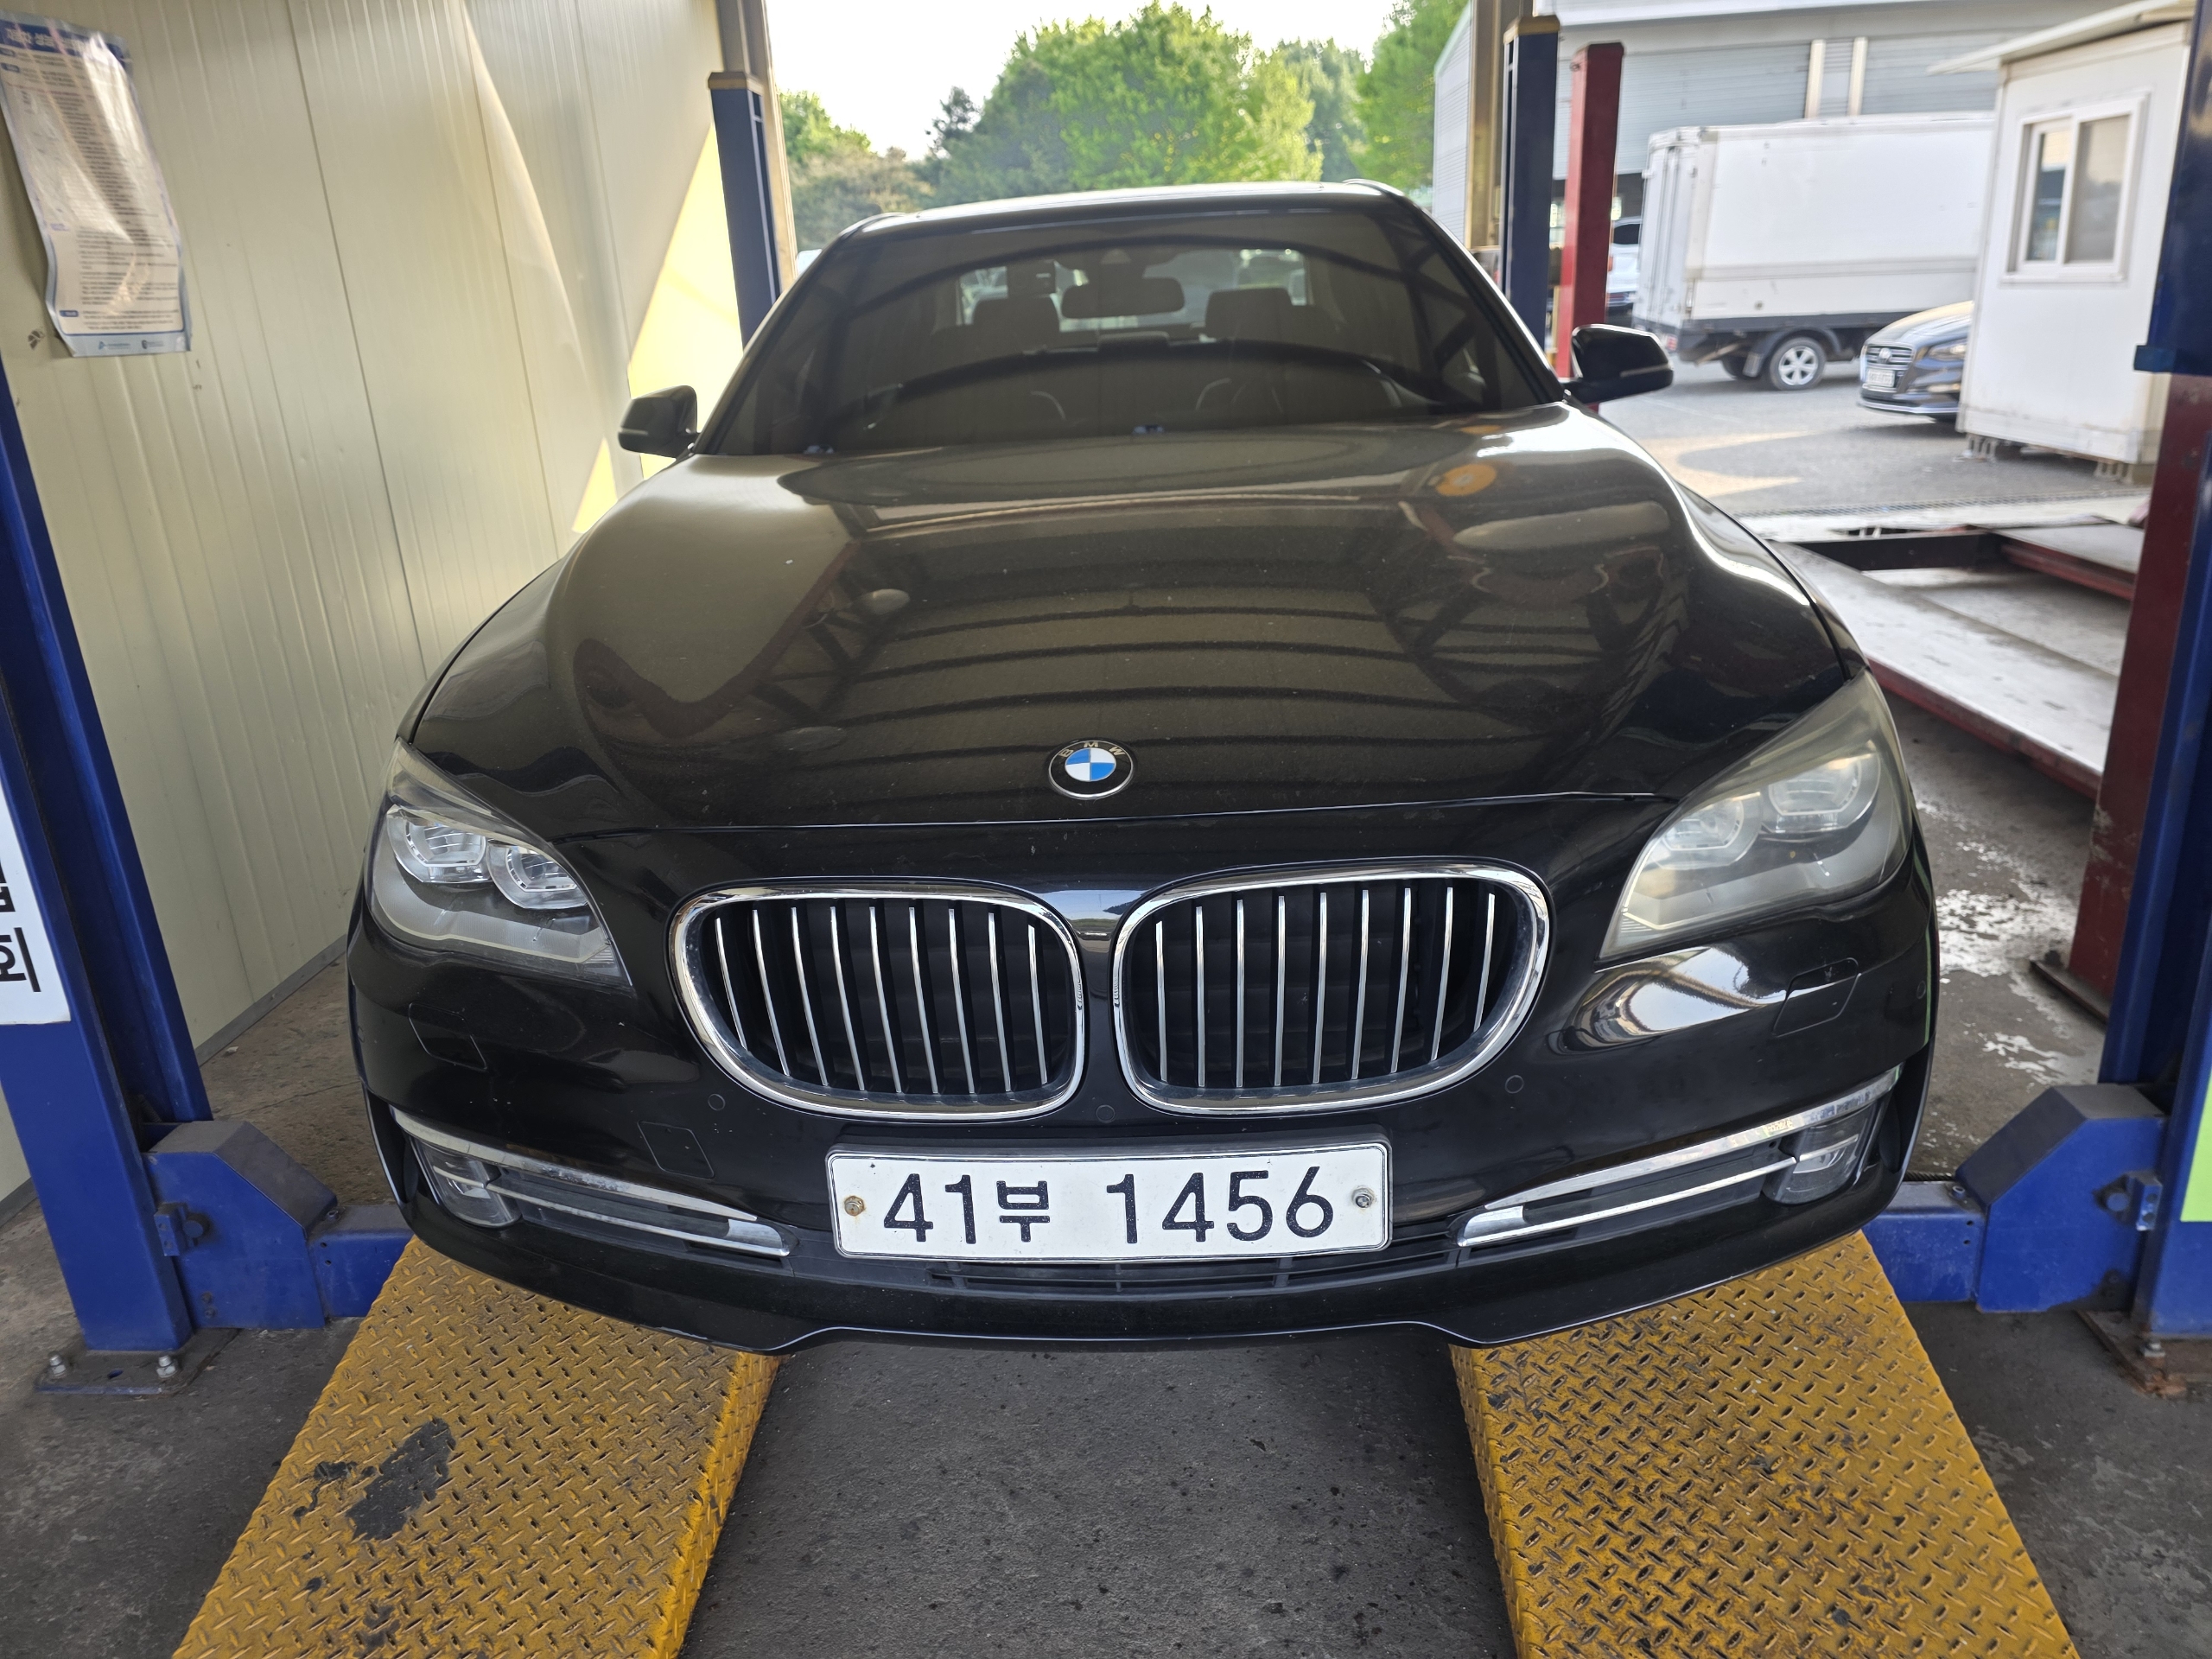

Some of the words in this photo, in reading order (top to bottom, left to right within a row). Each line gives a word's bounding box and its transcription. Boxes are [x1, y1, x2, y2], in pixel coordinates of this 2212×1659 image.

[1058, 741, 1125, 758] BMW
[883, 1173, 1051, 1244] 41부
[1106, 1166, 1334, 1244] 1456
